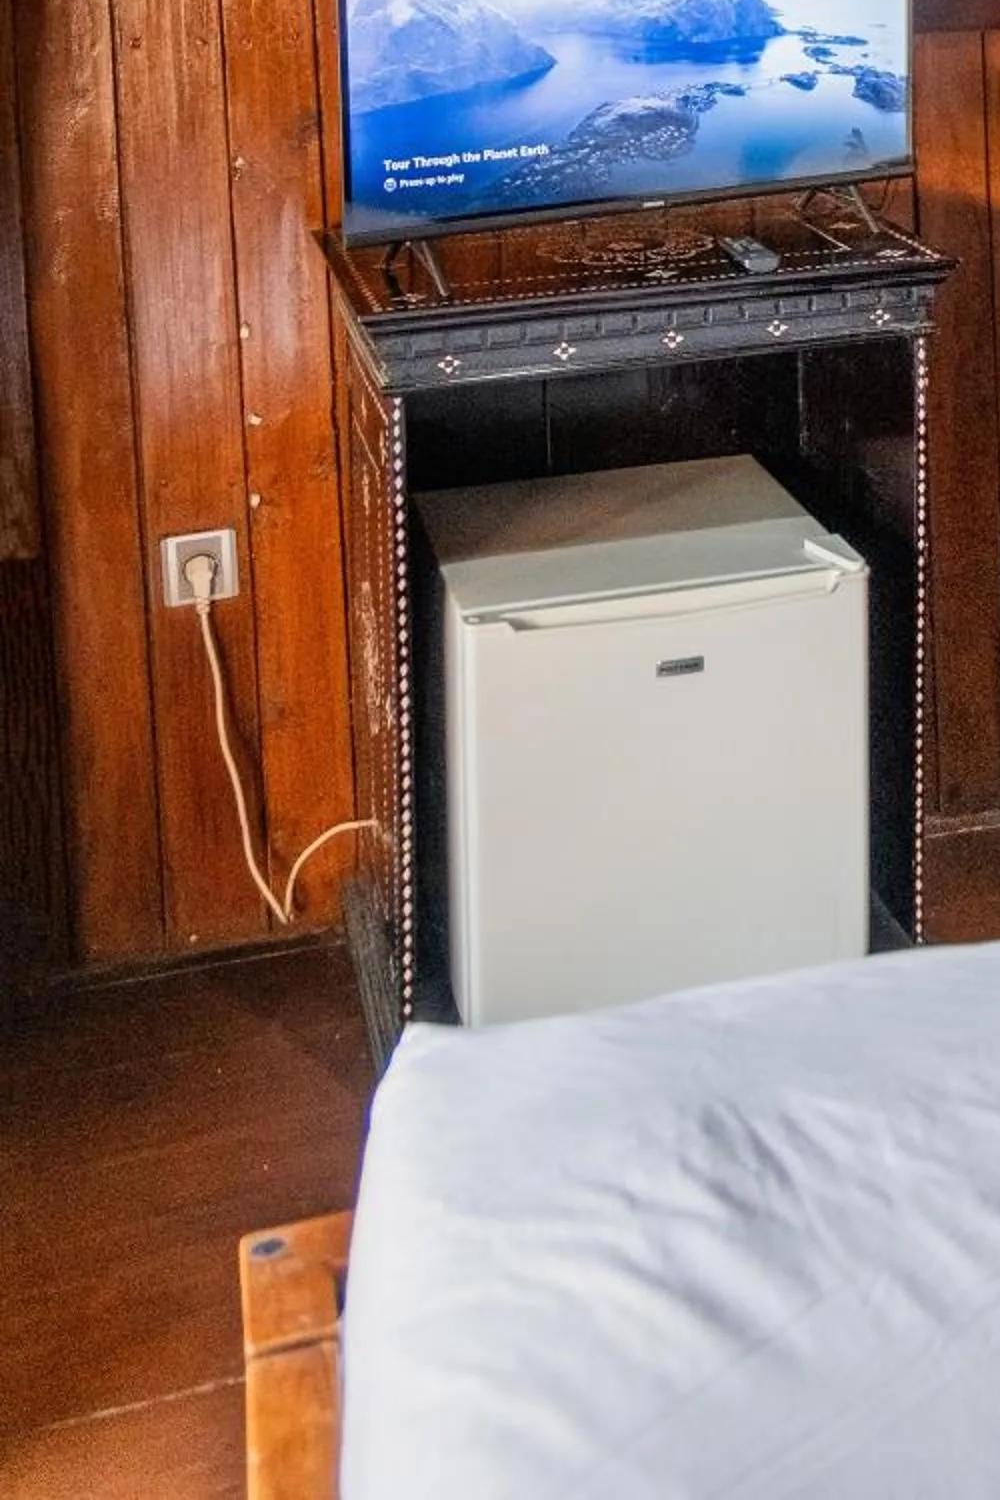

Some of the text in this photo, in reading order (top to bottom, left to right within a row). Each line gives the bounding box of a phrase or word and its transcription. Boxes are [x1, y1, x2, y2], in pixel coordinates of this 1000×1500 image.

[383, 143, 549, 171] Tour Through the Planet Earth
[399, 173, 465, 188] Press up to play
